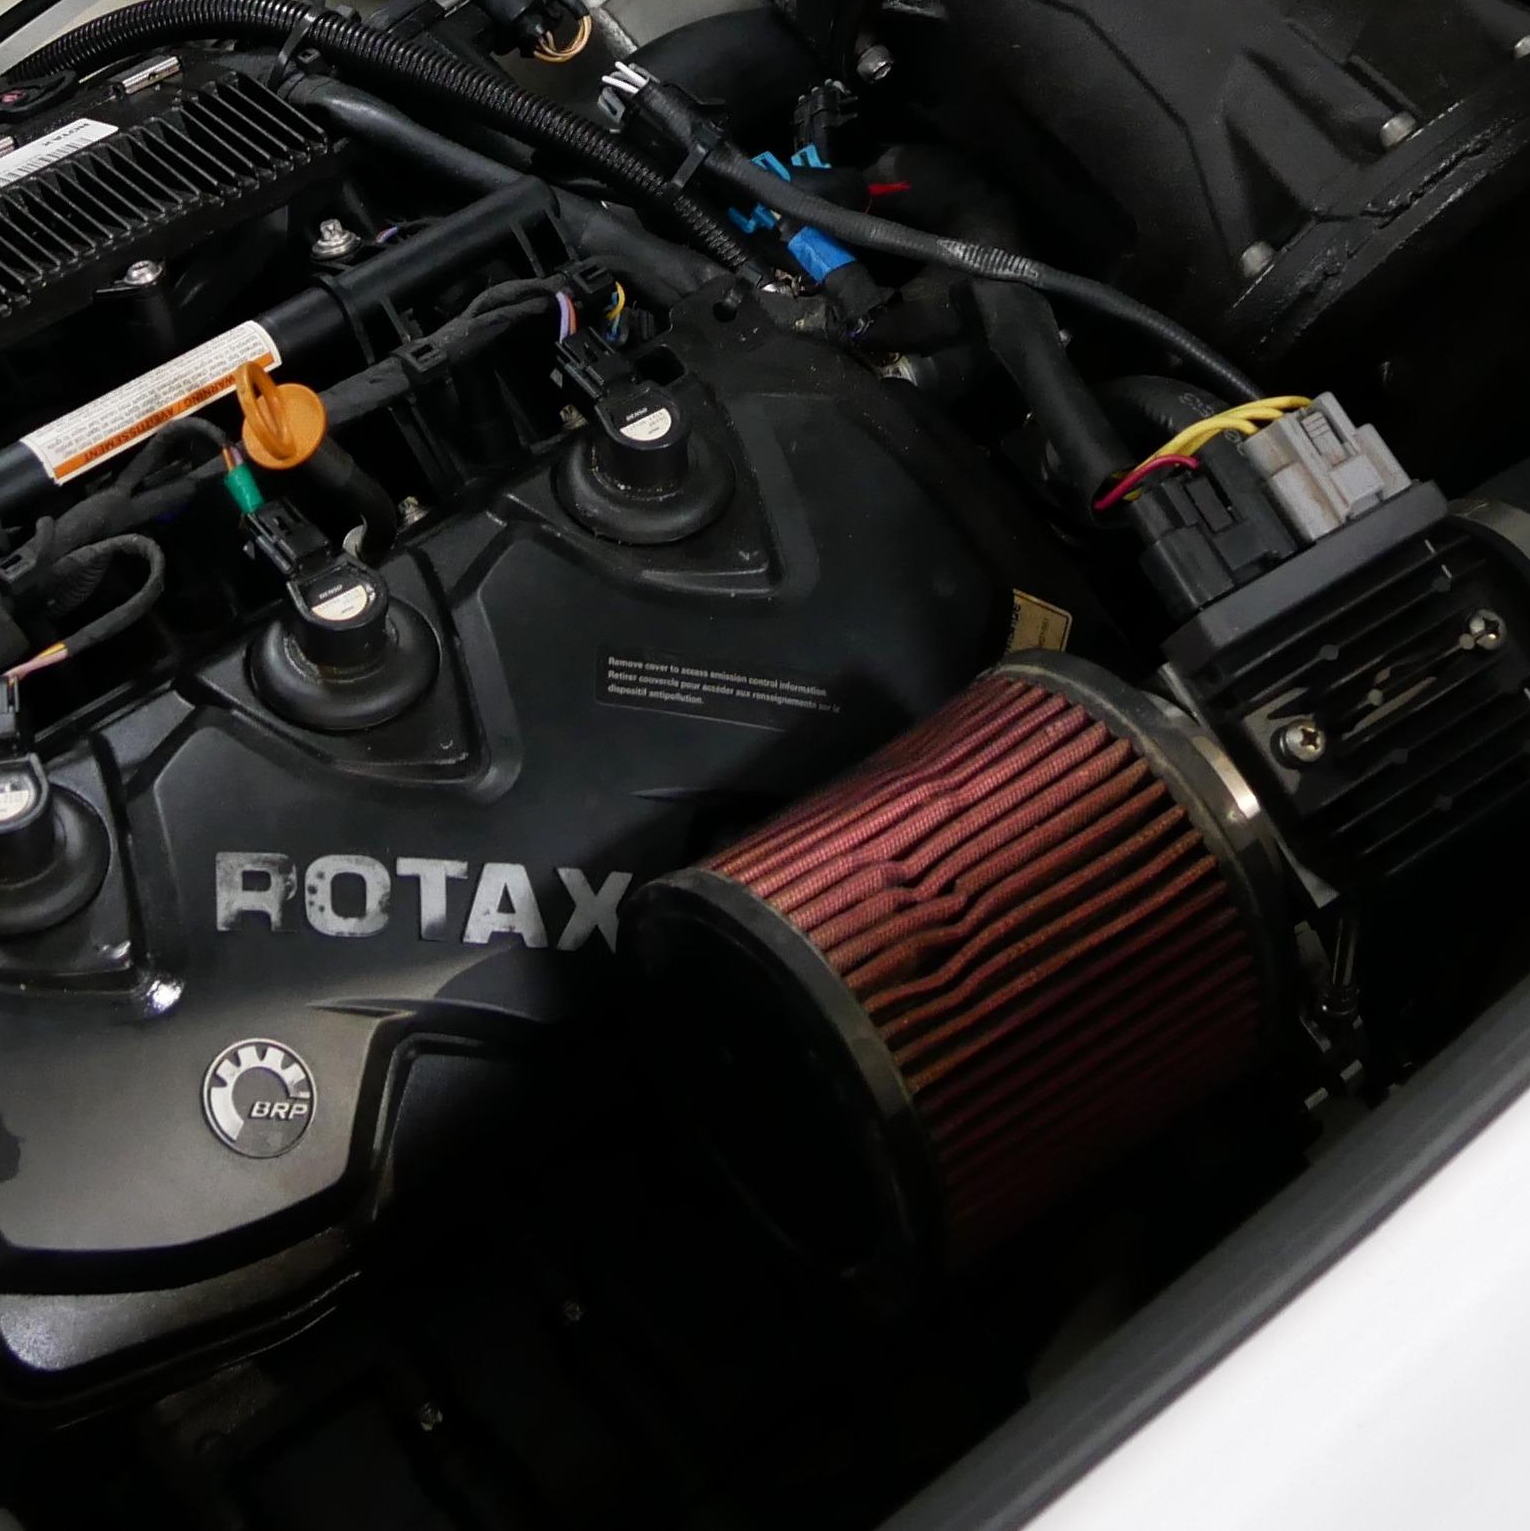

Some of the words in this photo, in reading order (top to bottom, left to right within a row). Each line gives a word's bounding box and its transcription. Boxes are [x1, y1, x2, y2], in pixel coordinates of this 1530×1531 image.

[608, 656, 643, 670] Remove
[645, 662, 669, 673] cover
[670, 664, 680, 674] to
[681, 667, 709, 678] access
[710, 670, 747, 683] emission
[748, 675, 778, 688] control
[779, 680, 827, 696] information
[608, 670, 638, 682] Retirer
[215, 852, 633, 953] ROTAX
[249, 1100, 310, 1121] BRP
